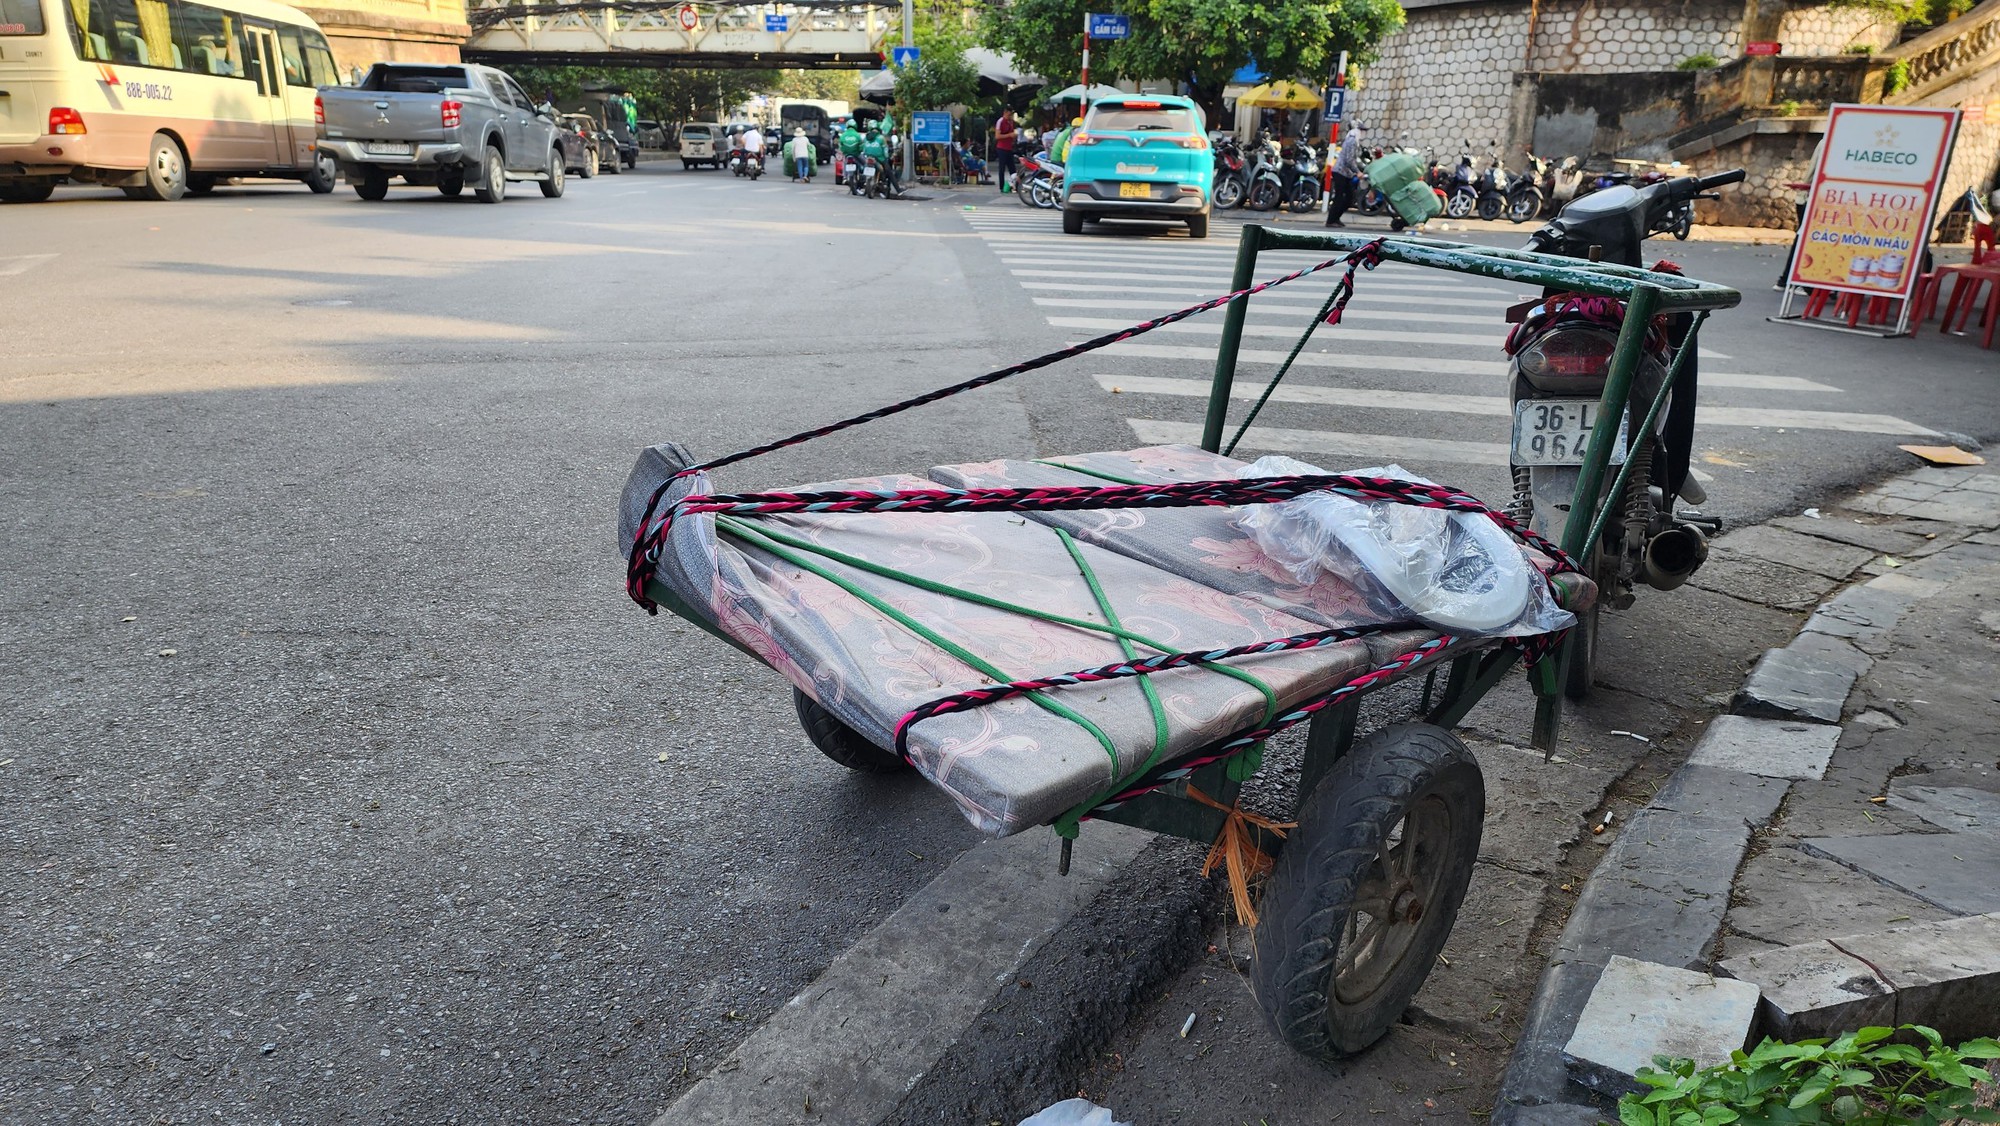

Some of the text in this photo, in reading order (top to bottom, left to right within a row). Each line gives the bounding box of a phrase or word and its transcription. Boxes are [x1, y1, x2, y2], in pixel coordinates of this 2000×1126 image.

[126, 82, 173, 100] 88B-005.22
[1329, 92, 1340, 113] P
[914, 118, 926, 135] P
[1845, 149, 1918, 165] HABECO
[1824, 188, 1858, 206] BIA
[1811, 229, 1910, 252] CÁC MÔN NHẬU
[1533, 405, 1594, 431] 36-L
[1531, 434, 1587, 461] 964
